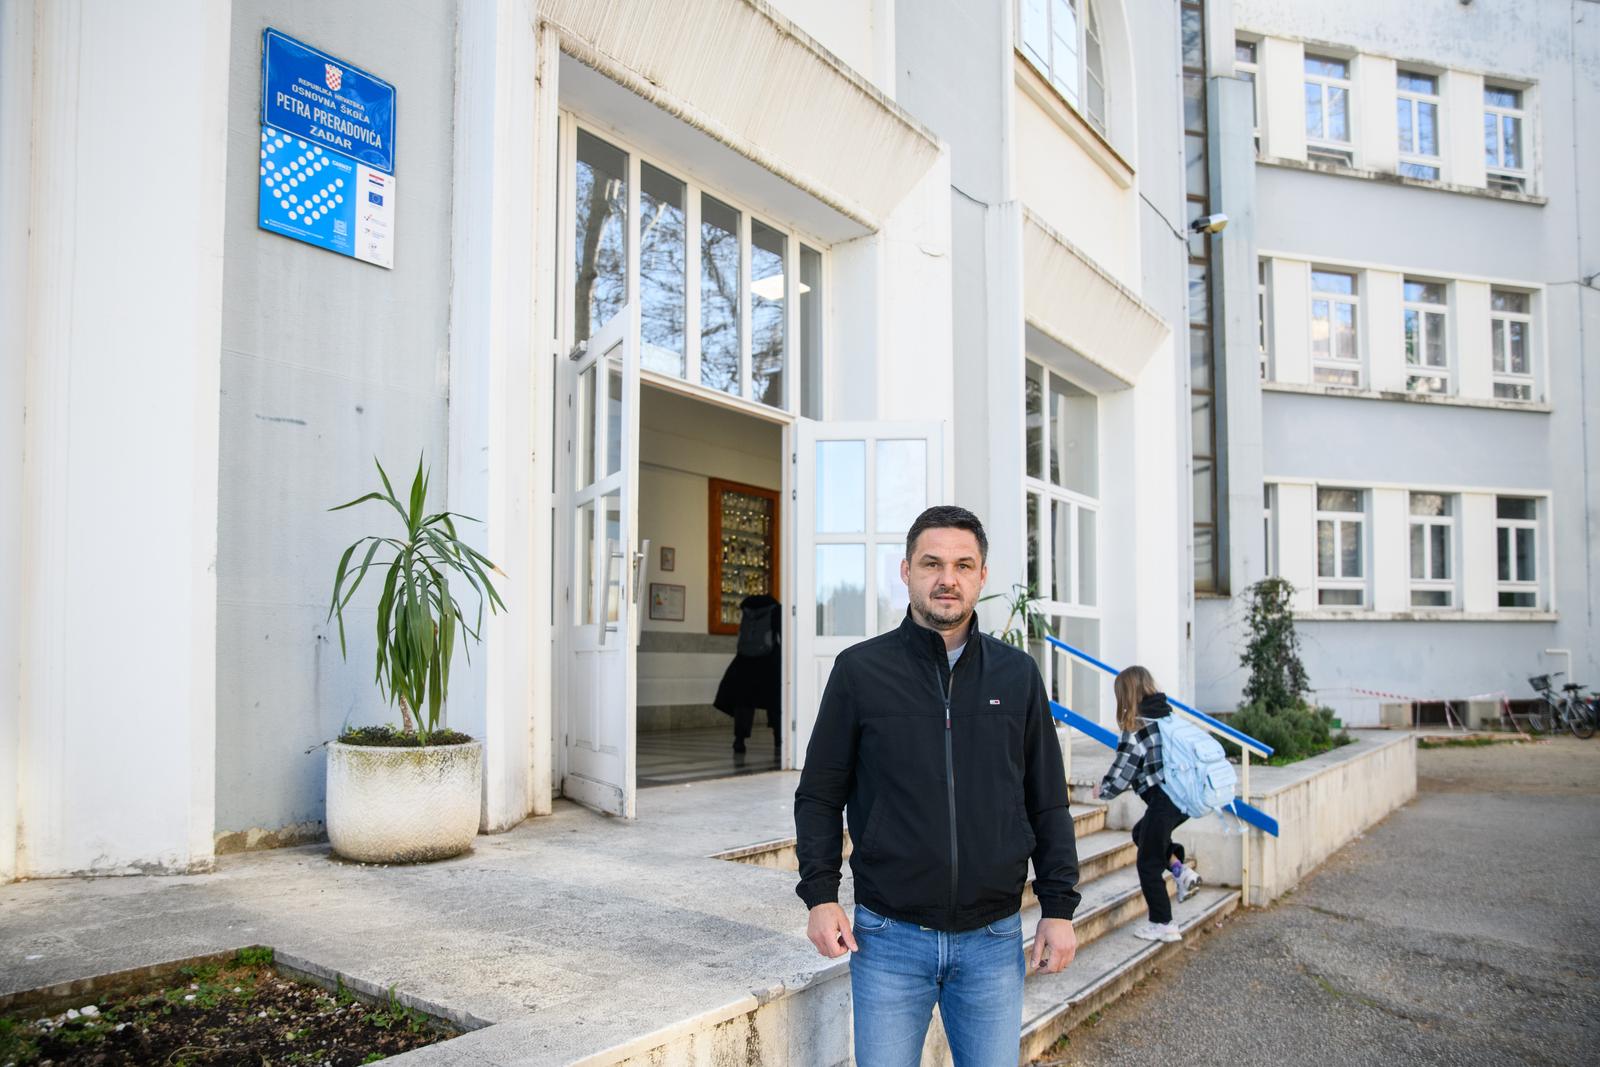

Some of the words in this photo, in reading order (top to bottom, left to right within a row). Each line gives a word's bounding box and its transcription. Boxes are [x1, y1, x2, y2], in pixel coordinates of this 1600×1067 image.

[298, 77, 333, 97] REPUBLIKA
[291, 84, 337, 110] OSNOVNA
[340, 103, 370, 124] ŠKOLA
[276, 92, 311, 120] PETRA
[313, 107, 382, 149] PRERADOVIĆA
[309, 125, 352, 150] ZADAR
